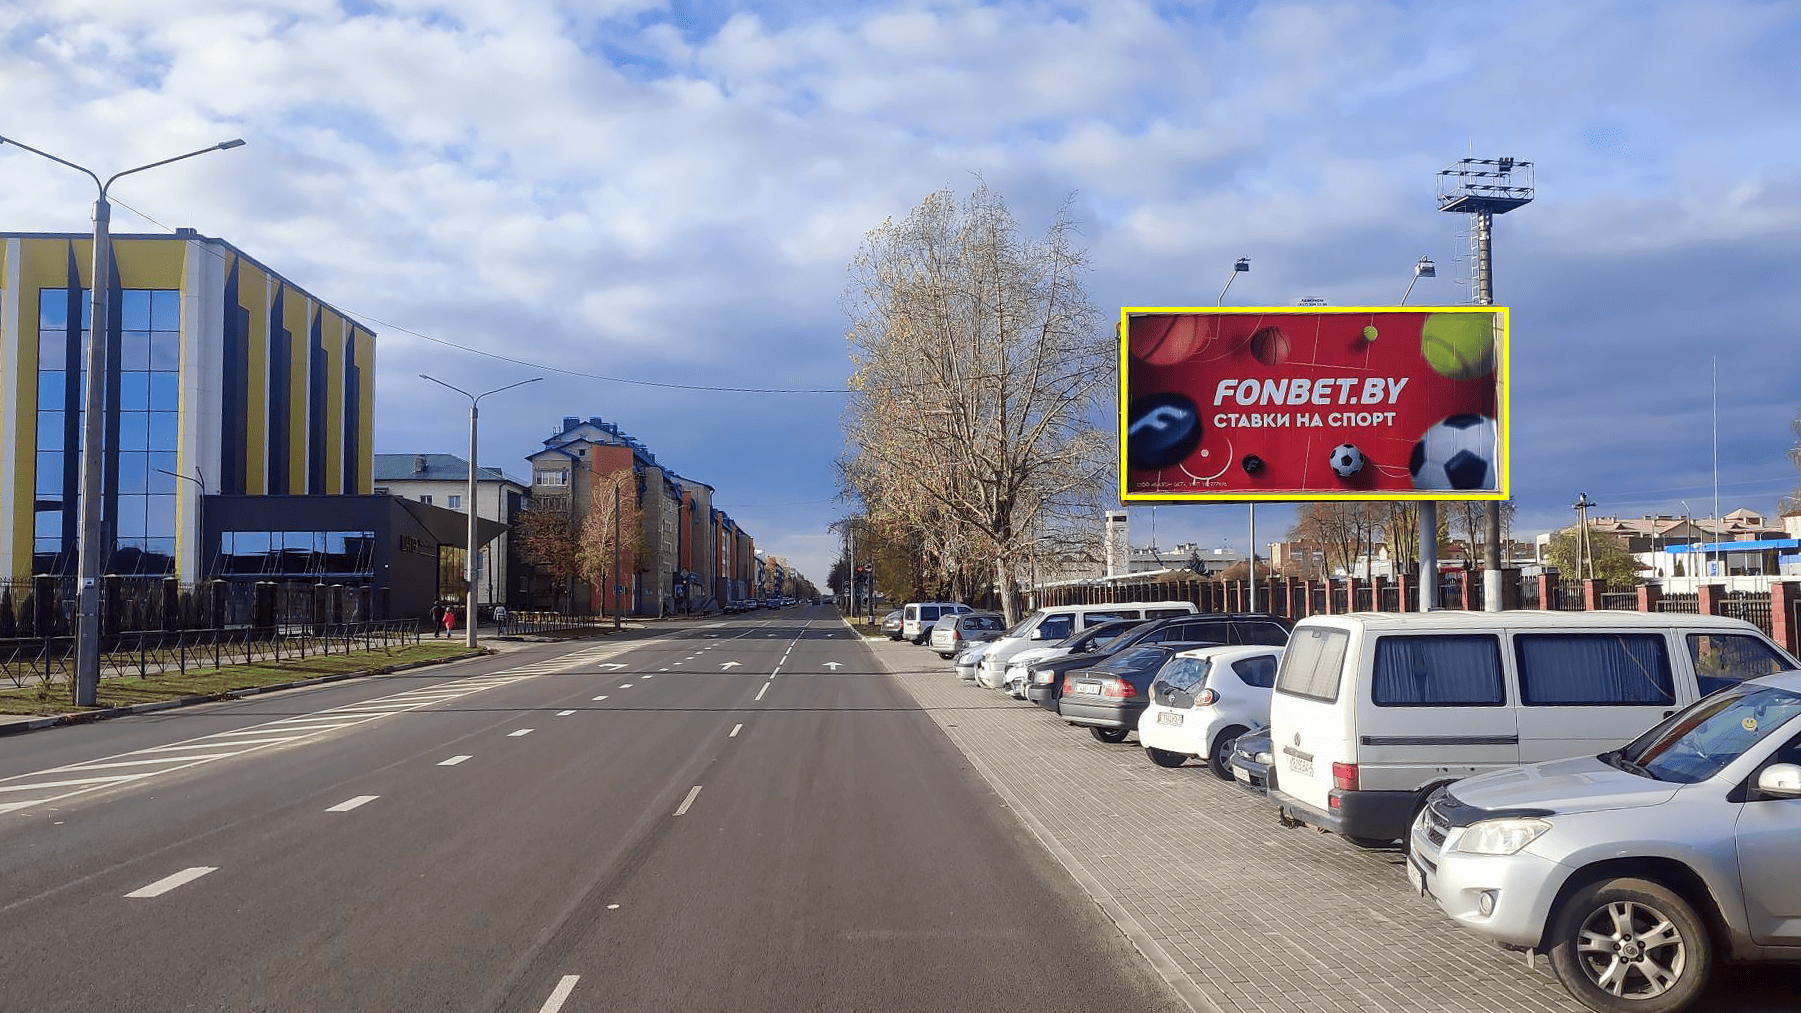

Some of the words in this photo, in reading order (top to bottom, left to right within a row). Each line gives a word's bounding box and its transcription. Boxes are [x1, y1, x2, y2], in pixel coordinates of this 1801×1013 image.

[1213, 377, 1409, 406] FONBET.BY
[1213, 412, 1290, 428] СТАВКИ
[1296, 412, 1324, 428] НА
[1327, 411, 1397, 428] СПОРТ
